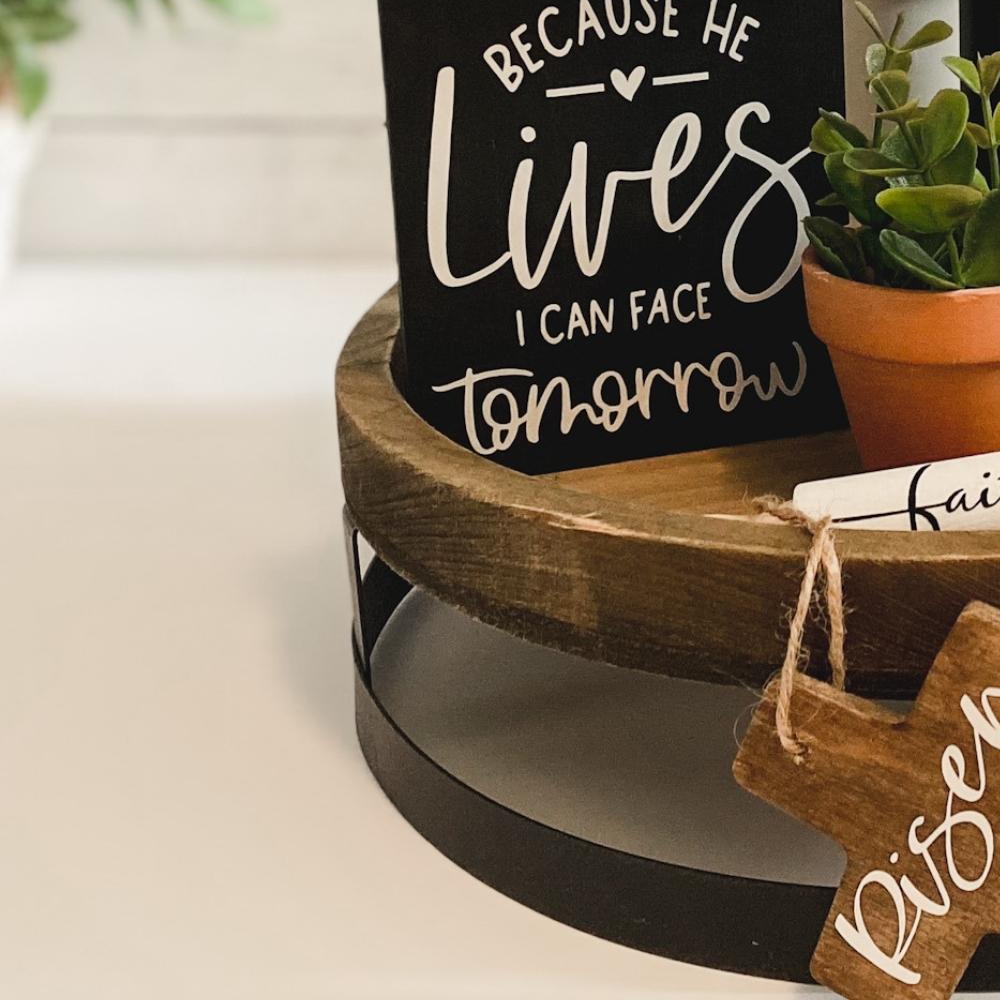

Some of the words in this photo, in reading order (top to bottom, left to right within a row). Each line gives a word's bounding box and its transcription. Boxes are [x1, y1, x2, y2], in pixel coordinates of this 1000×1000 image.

[427, 66, 812, 303] Lives
[516, 310, 525, 346] I
[540, 298, 615, 346] CAN
[630, 281, 712, 330] FACE
[432, 341, 807, 455] tomorrow
